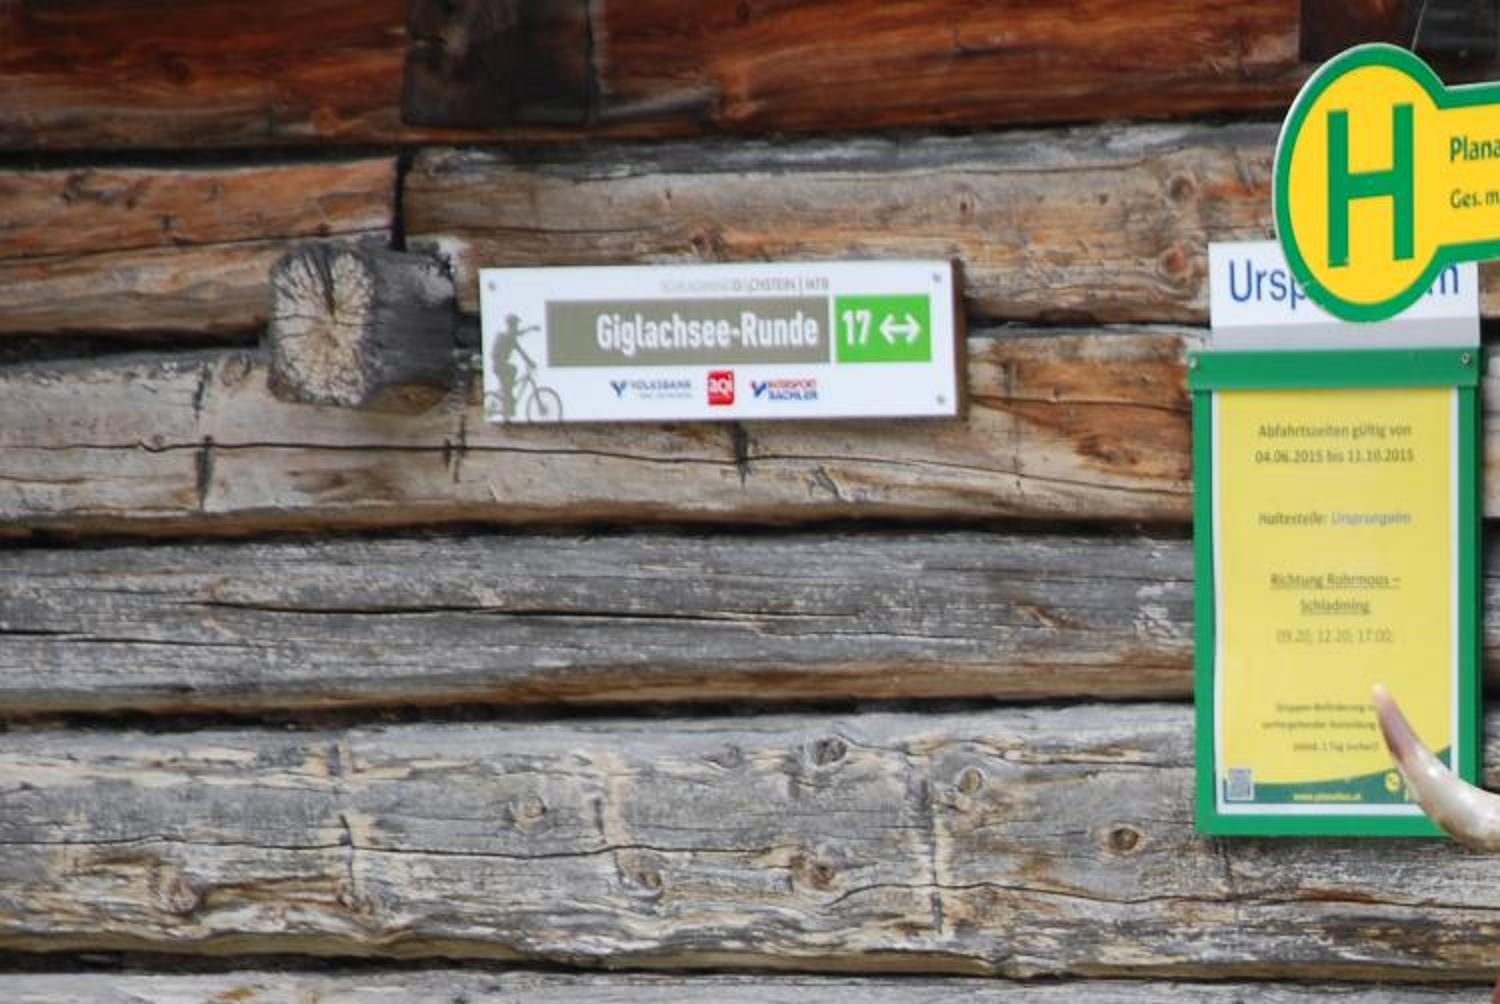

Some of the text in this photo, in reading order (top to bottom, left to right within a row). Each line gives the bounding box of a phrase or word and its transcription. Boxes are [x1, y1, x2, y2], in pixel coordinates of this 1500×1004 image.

[1326, 103, 1415, 268] H
[1450, 188, 1483, 209] Ges.
[596, 309, 872, 356] Giglachsee-Runde 17
[1327, 448, 1345, 463] bis
